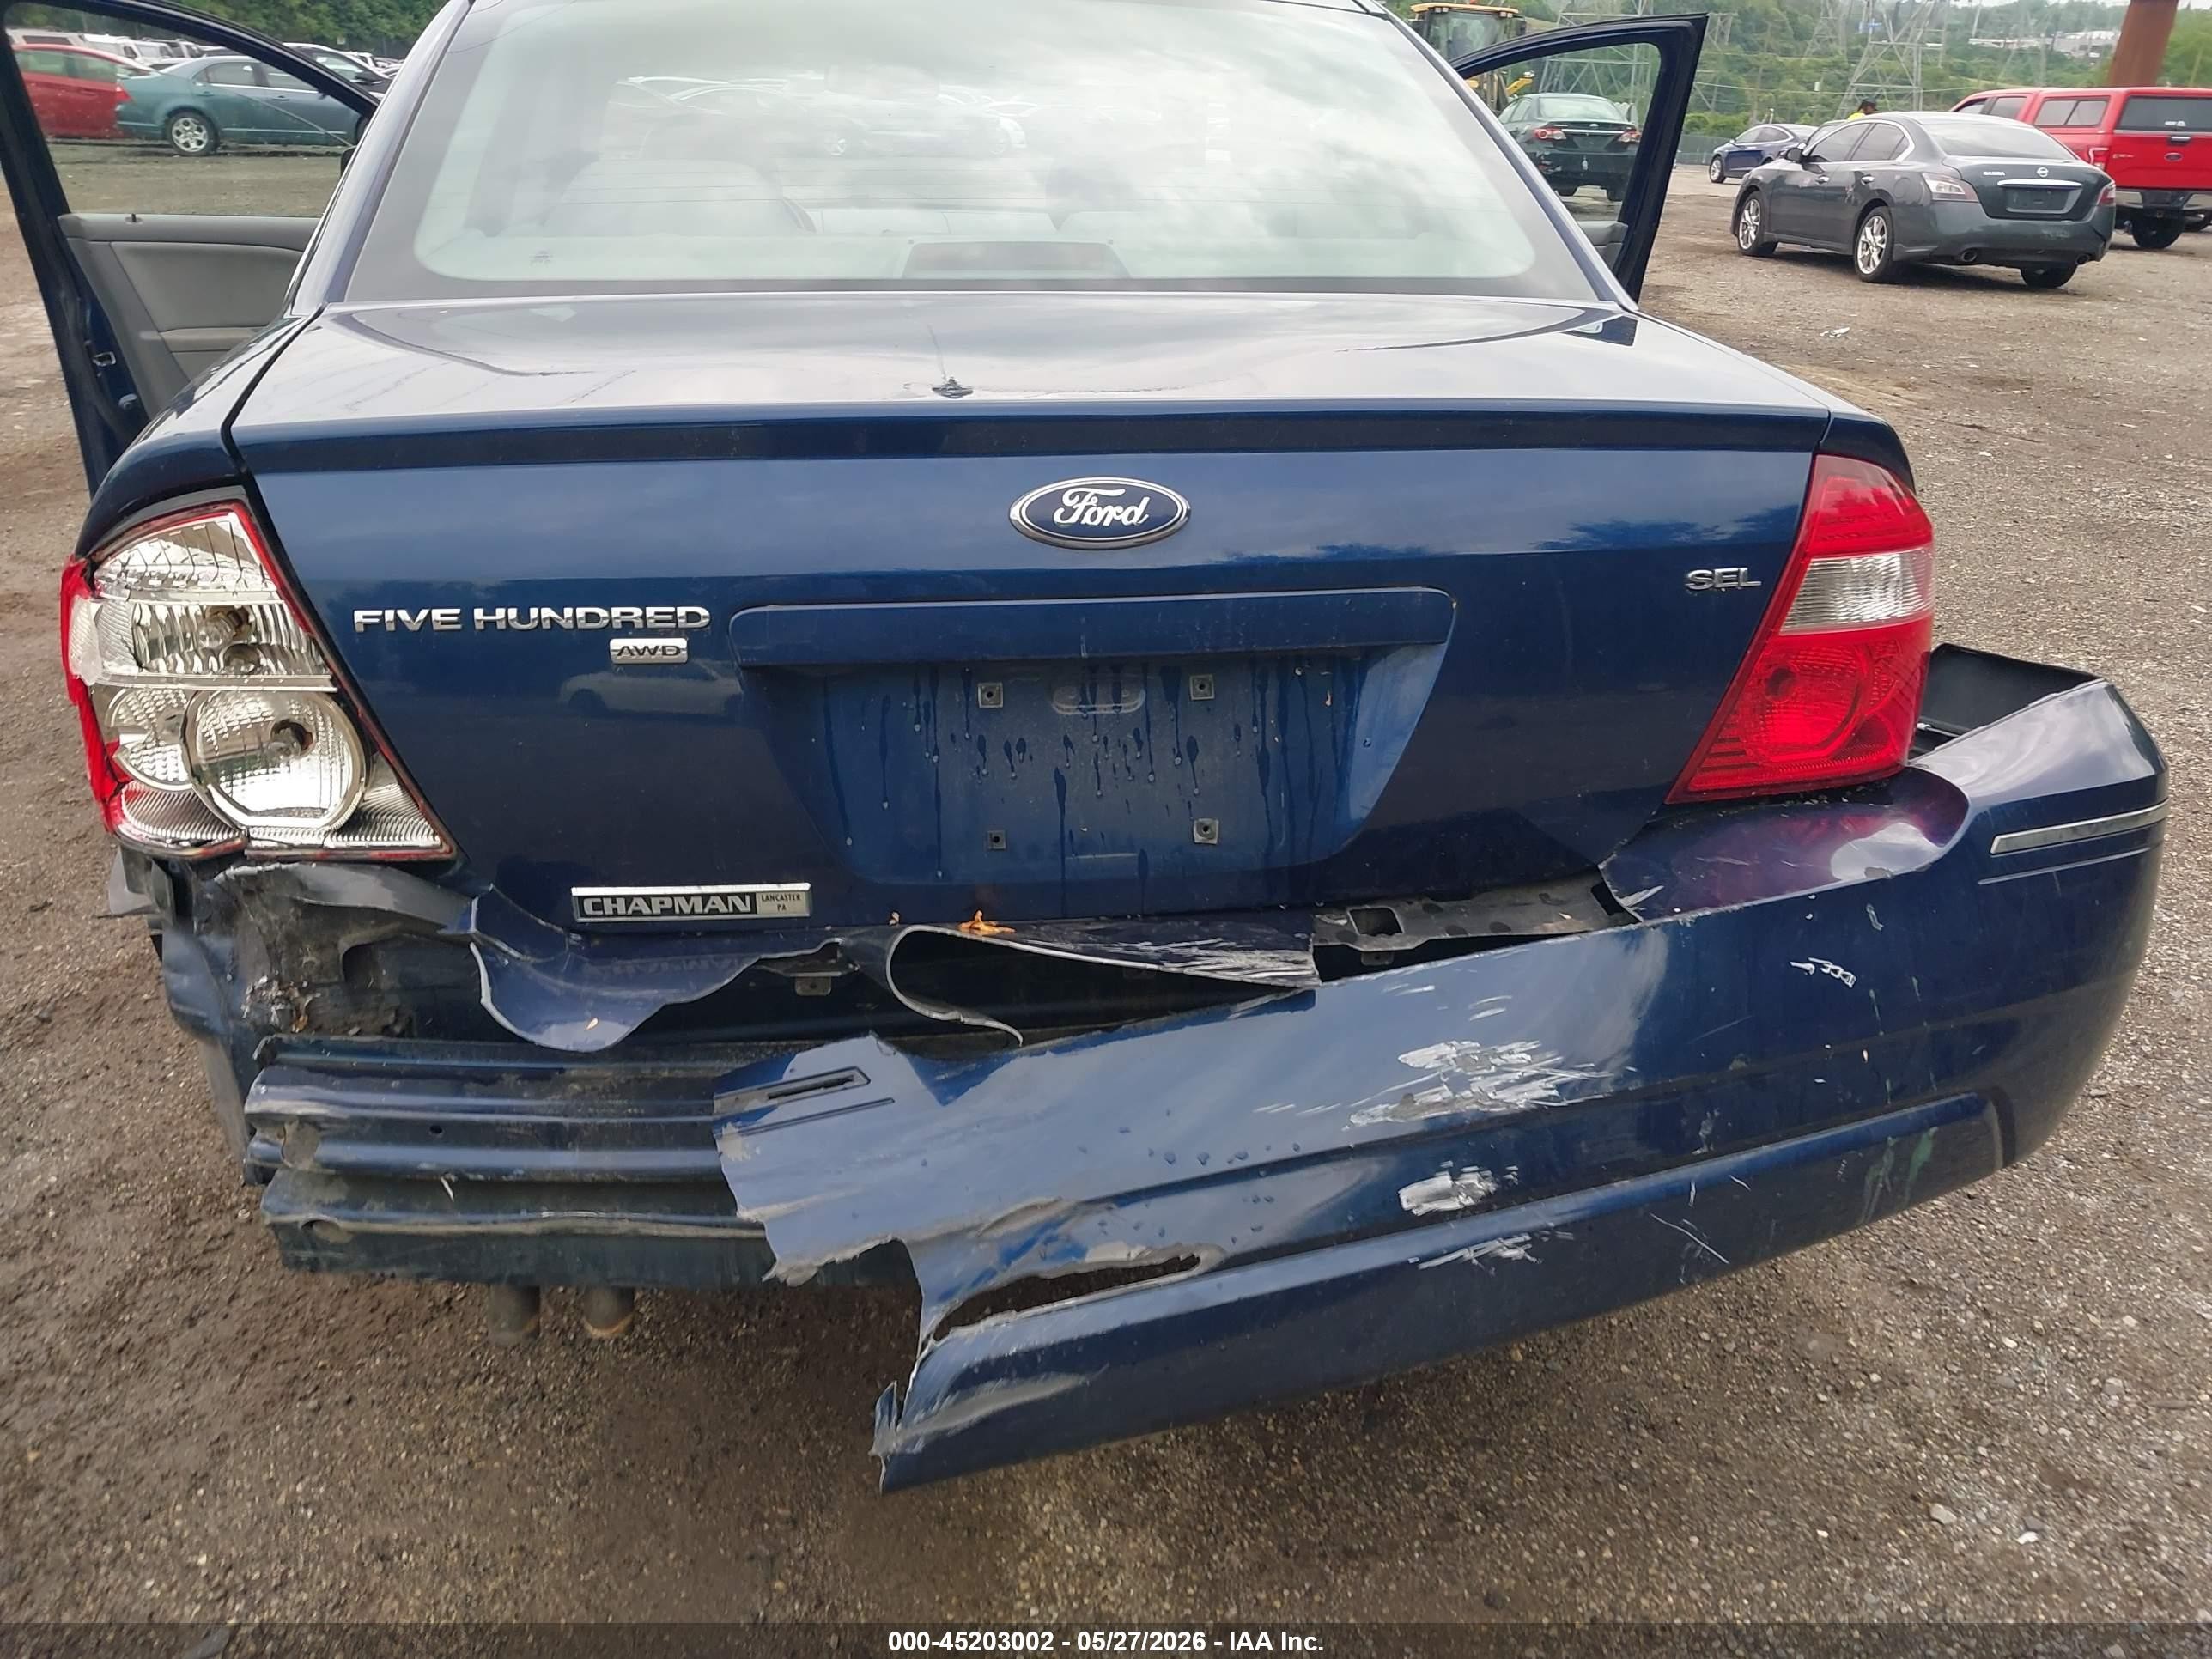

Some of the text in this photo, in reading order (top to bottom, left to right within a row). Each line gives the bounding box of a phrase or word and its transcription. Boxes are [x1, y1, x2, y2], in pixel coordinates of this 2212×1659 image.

[1053, 486, 1151, 526] Ford
[1685, 568, 1762, 590] SEL
[353, 605, 712, 633] FIVE HUNDRED
[616, 644, 684, 659] AWD
[582, 894, 752, 916] CHAPMAN
[761, 893, 802, 902] LANCASTER
[776, 903, 787, 913] PA
